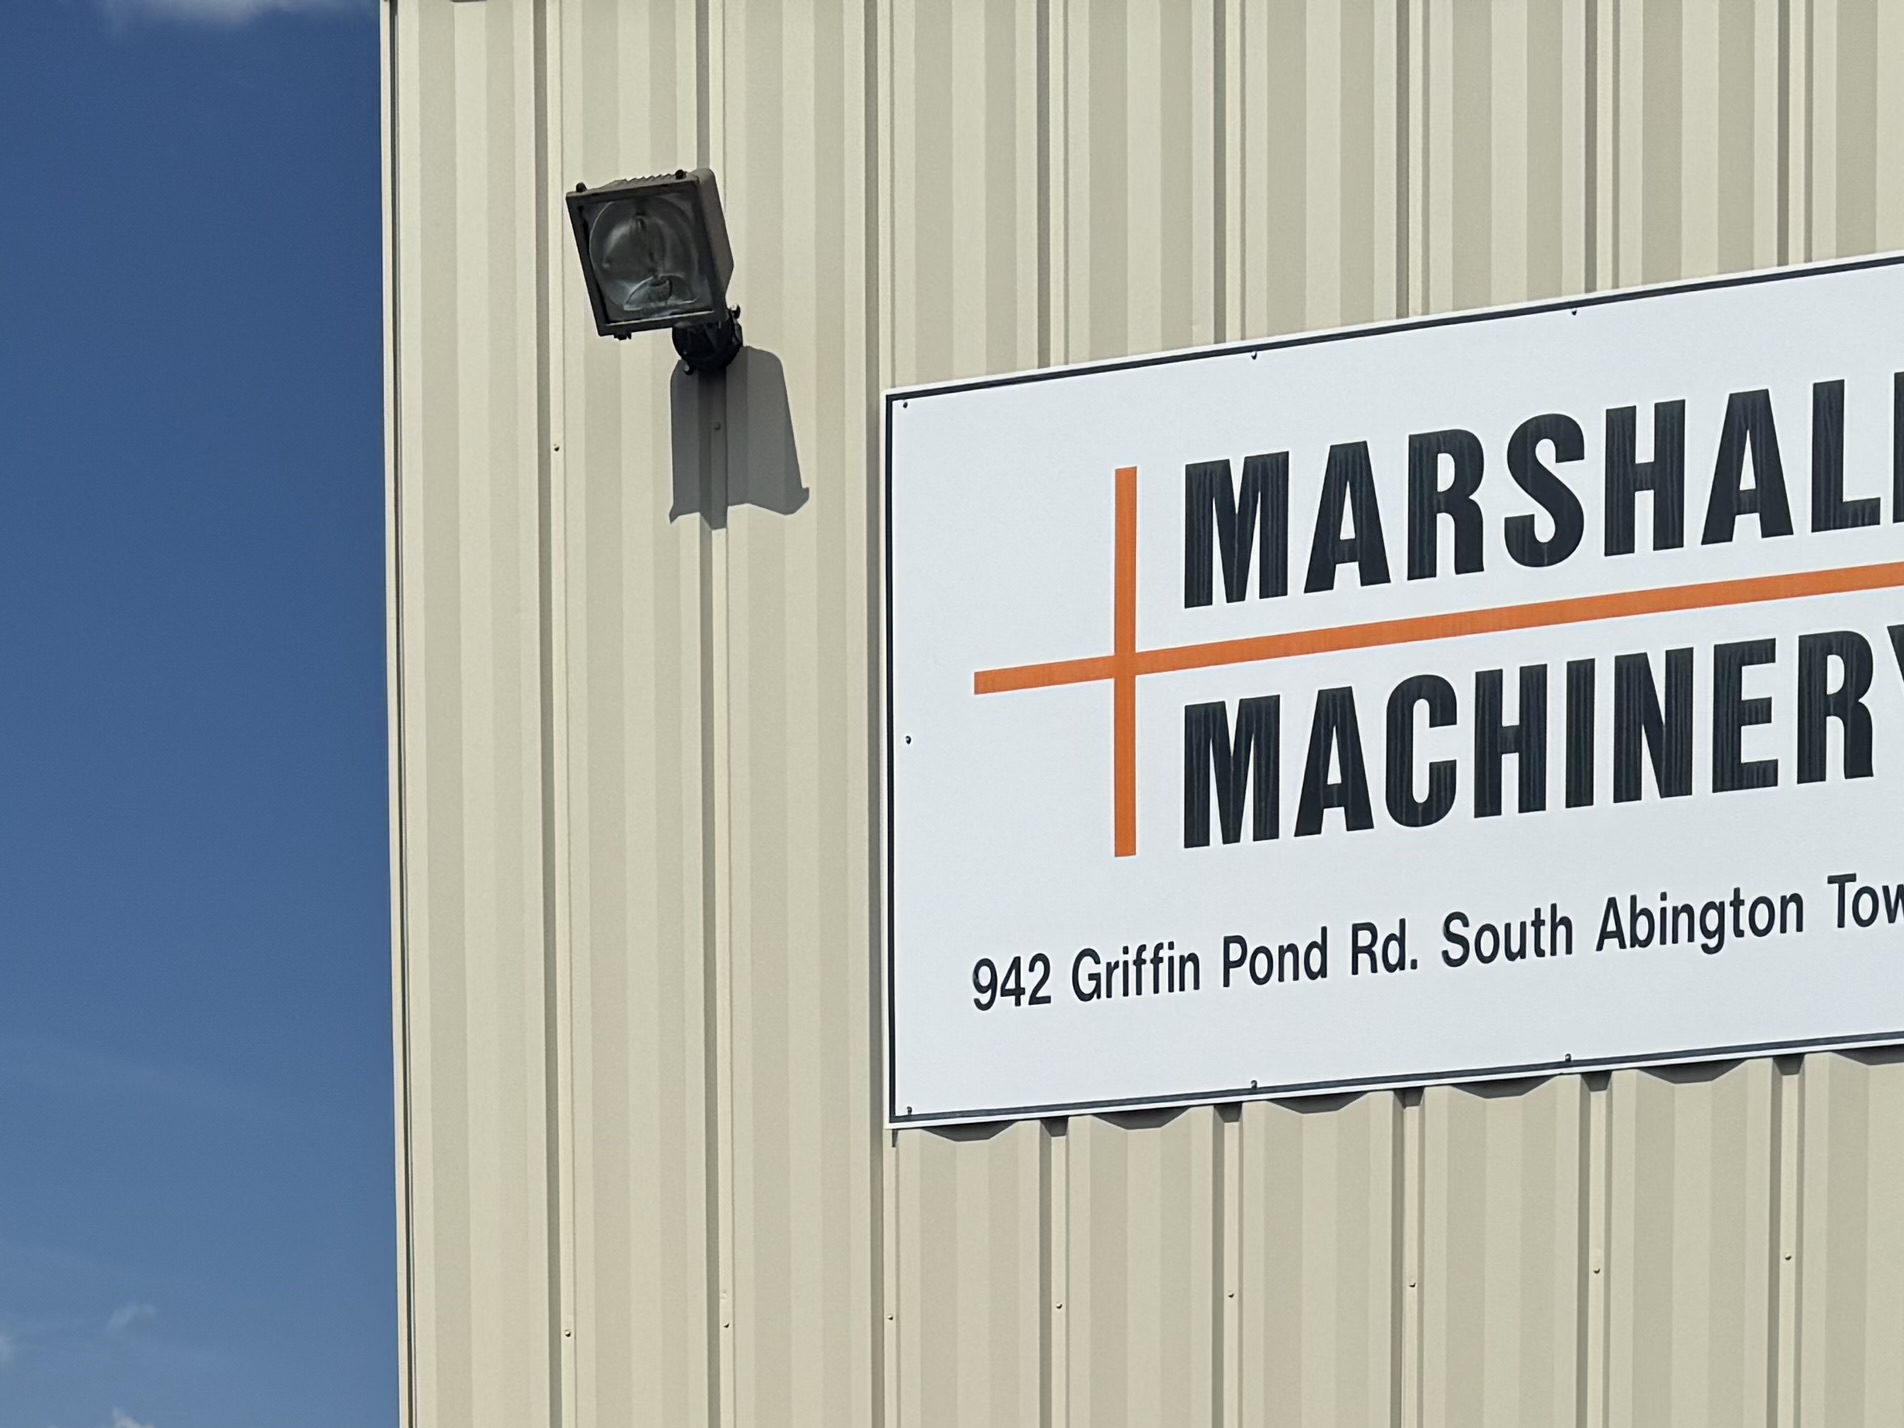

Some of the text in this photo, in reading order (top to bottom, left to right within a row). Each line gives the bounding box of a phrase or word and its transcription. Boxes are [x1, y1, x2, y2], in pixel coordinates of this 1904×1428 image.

[972, 952, 1052, 1012] 942
[1071, 940, 1200, 1002] Griffin
[1222, 926, 1328, 988] Pond
[1351, 916, 1417, 976] Rd.
[1441, 903, 1573, 968] South
[1595, 887, 1804, 955] Abington
